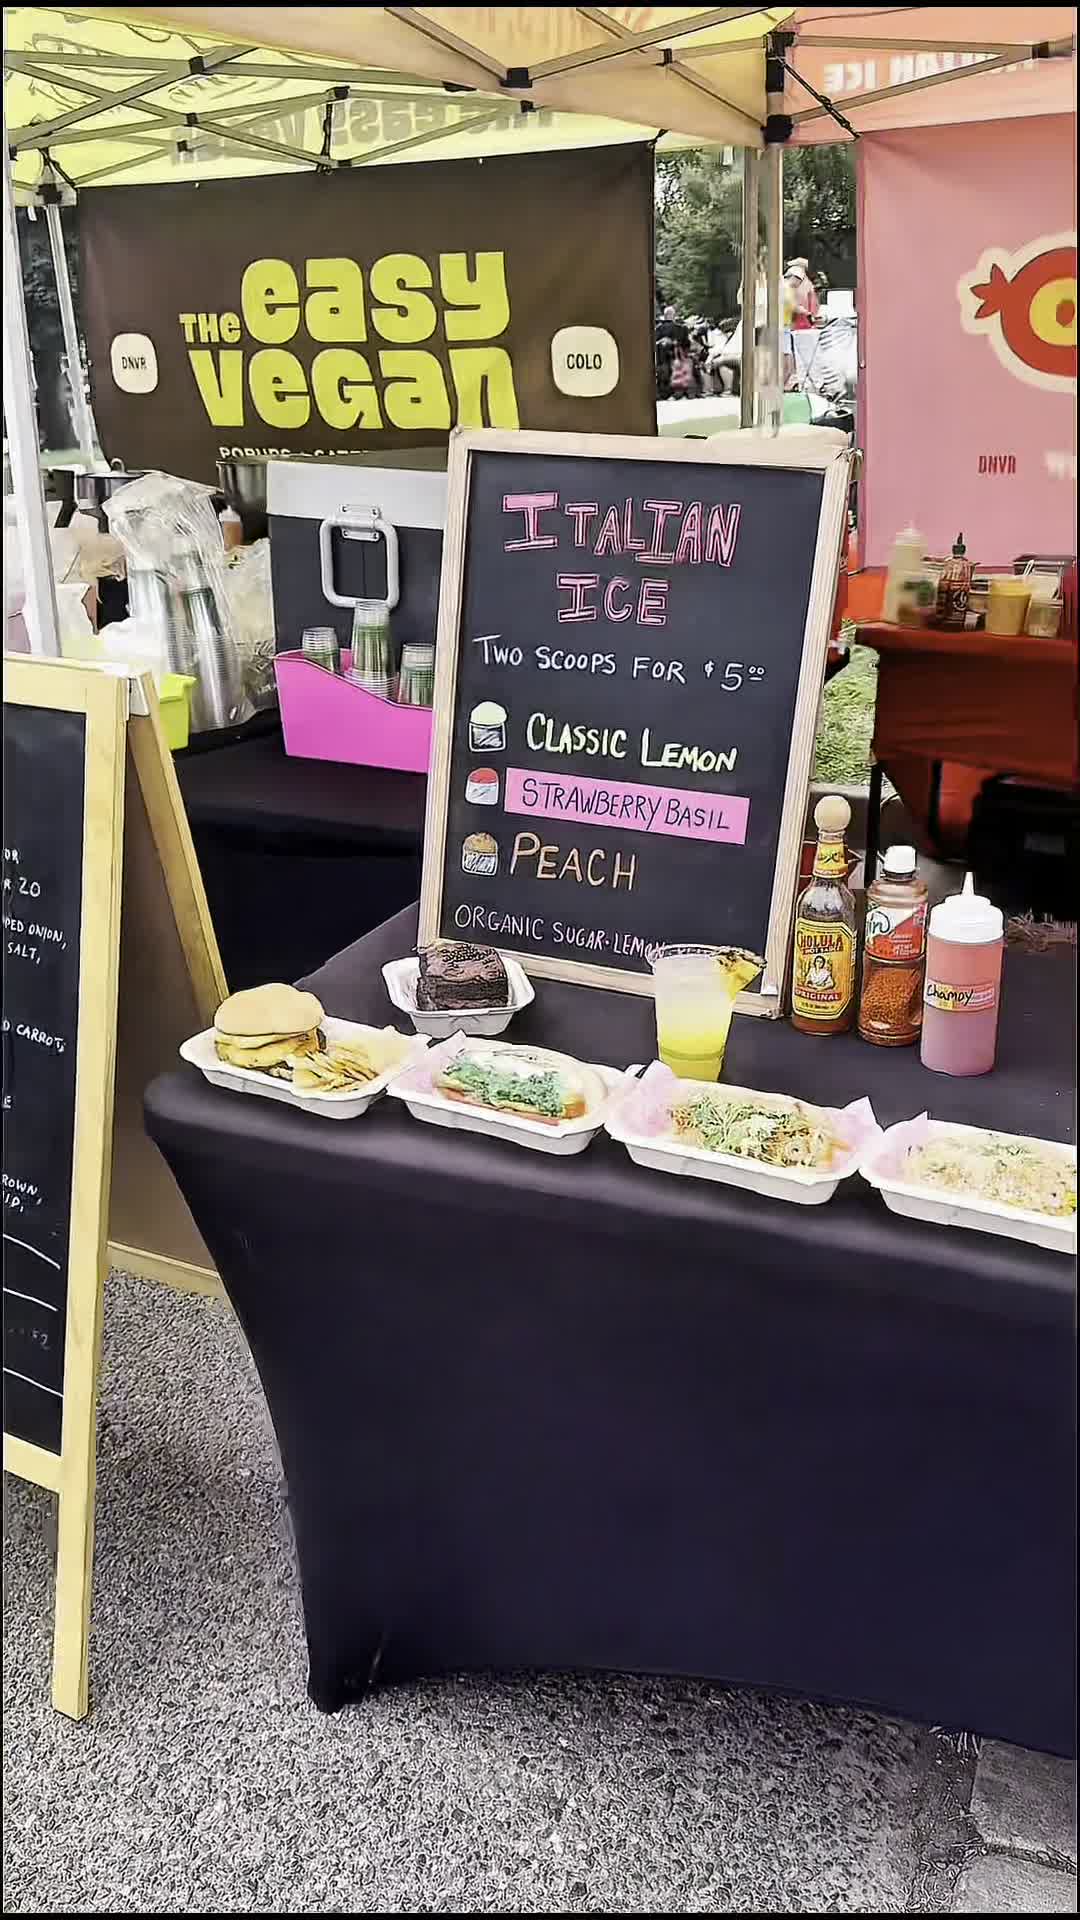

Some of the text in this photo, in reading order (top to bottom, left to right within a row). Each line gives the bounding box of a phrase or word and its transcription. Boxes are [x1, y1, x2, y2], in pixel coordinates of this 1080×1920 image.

[240, 251, 510, 345] easy
[121, 356, 148, 370] DNVR
[566, 353, 603, 371] COLO
[977, 455, 1017, 474] DNVR
[502, 491, 743, 568] ITALIAN
[556, 572, 670, 627] ICE
[472, 634, 524, 667] TWO
[535, 646, 617, 675] SCOOPS
[632, 656, 687, 684] FOR
[525, 712, 738, 773] CLASSIC LEMON
[521, 778, 731, 831] STRAWBERRY BASIL
[509, 831, 637, 892] PEACH
[453, 904, 545, 941] ORGANIC
[926, 984, 974, 1007] Chamoy
